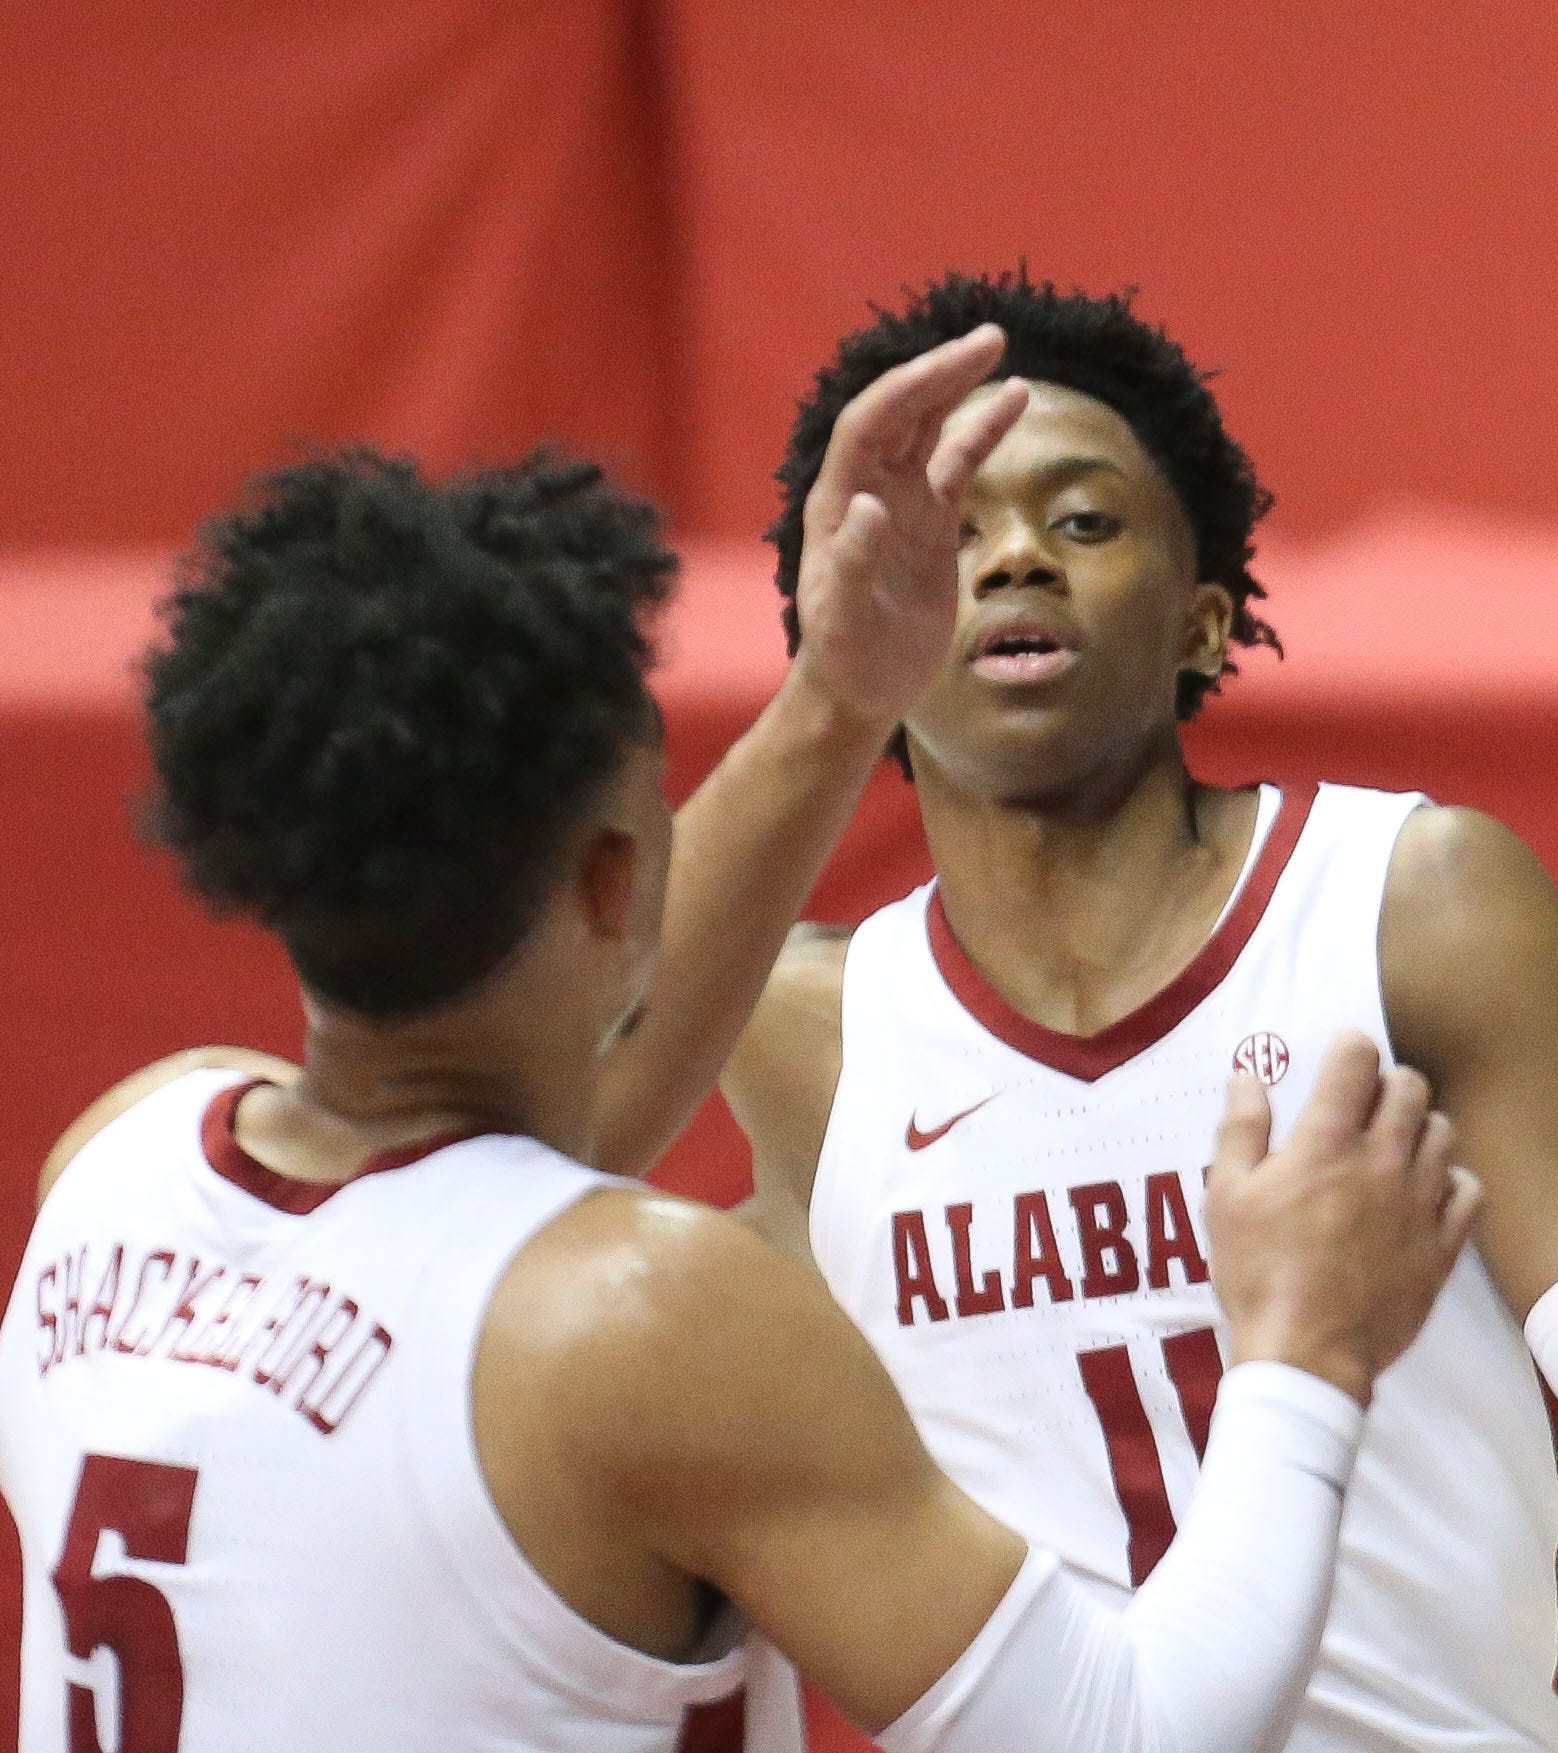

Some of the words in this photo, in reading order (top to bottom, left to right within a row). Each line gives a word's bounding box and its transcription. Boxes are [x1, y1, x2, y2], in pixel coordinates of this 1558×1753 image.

[1233, 1032, 1289, 1085] SEC
[891, 1166, 1212, 1327] ALABA
[51, 1451, 200, 1753] 5
